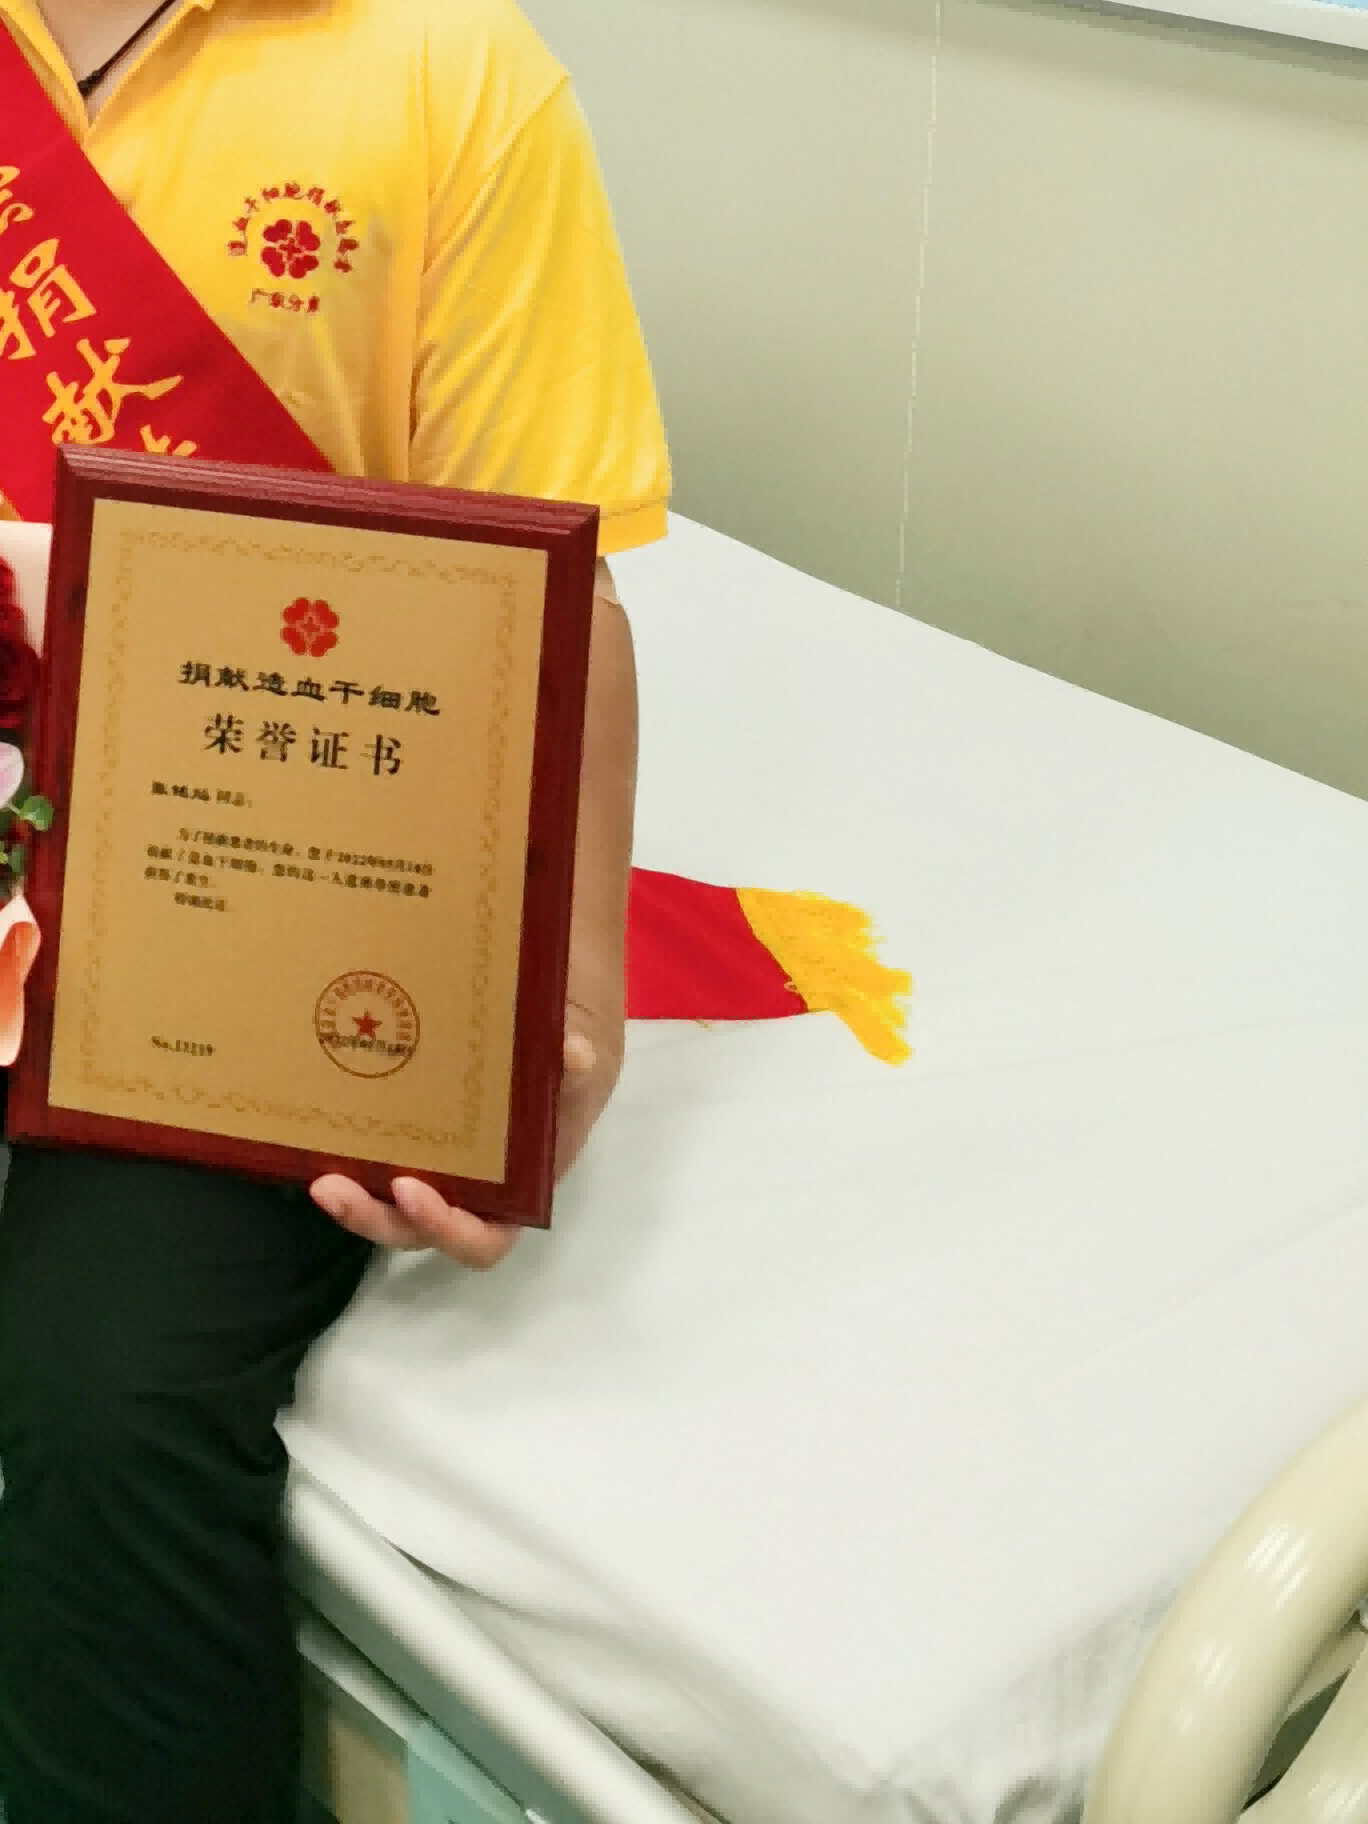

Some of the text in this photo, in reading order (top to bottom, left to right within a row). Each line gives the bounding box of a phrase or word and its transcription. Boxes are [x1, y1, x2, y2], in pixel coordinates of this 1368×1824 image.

[177, 660, 441, 716] 捐献造血干细胞
[203, 712, 403, 776] 荣誉证书
